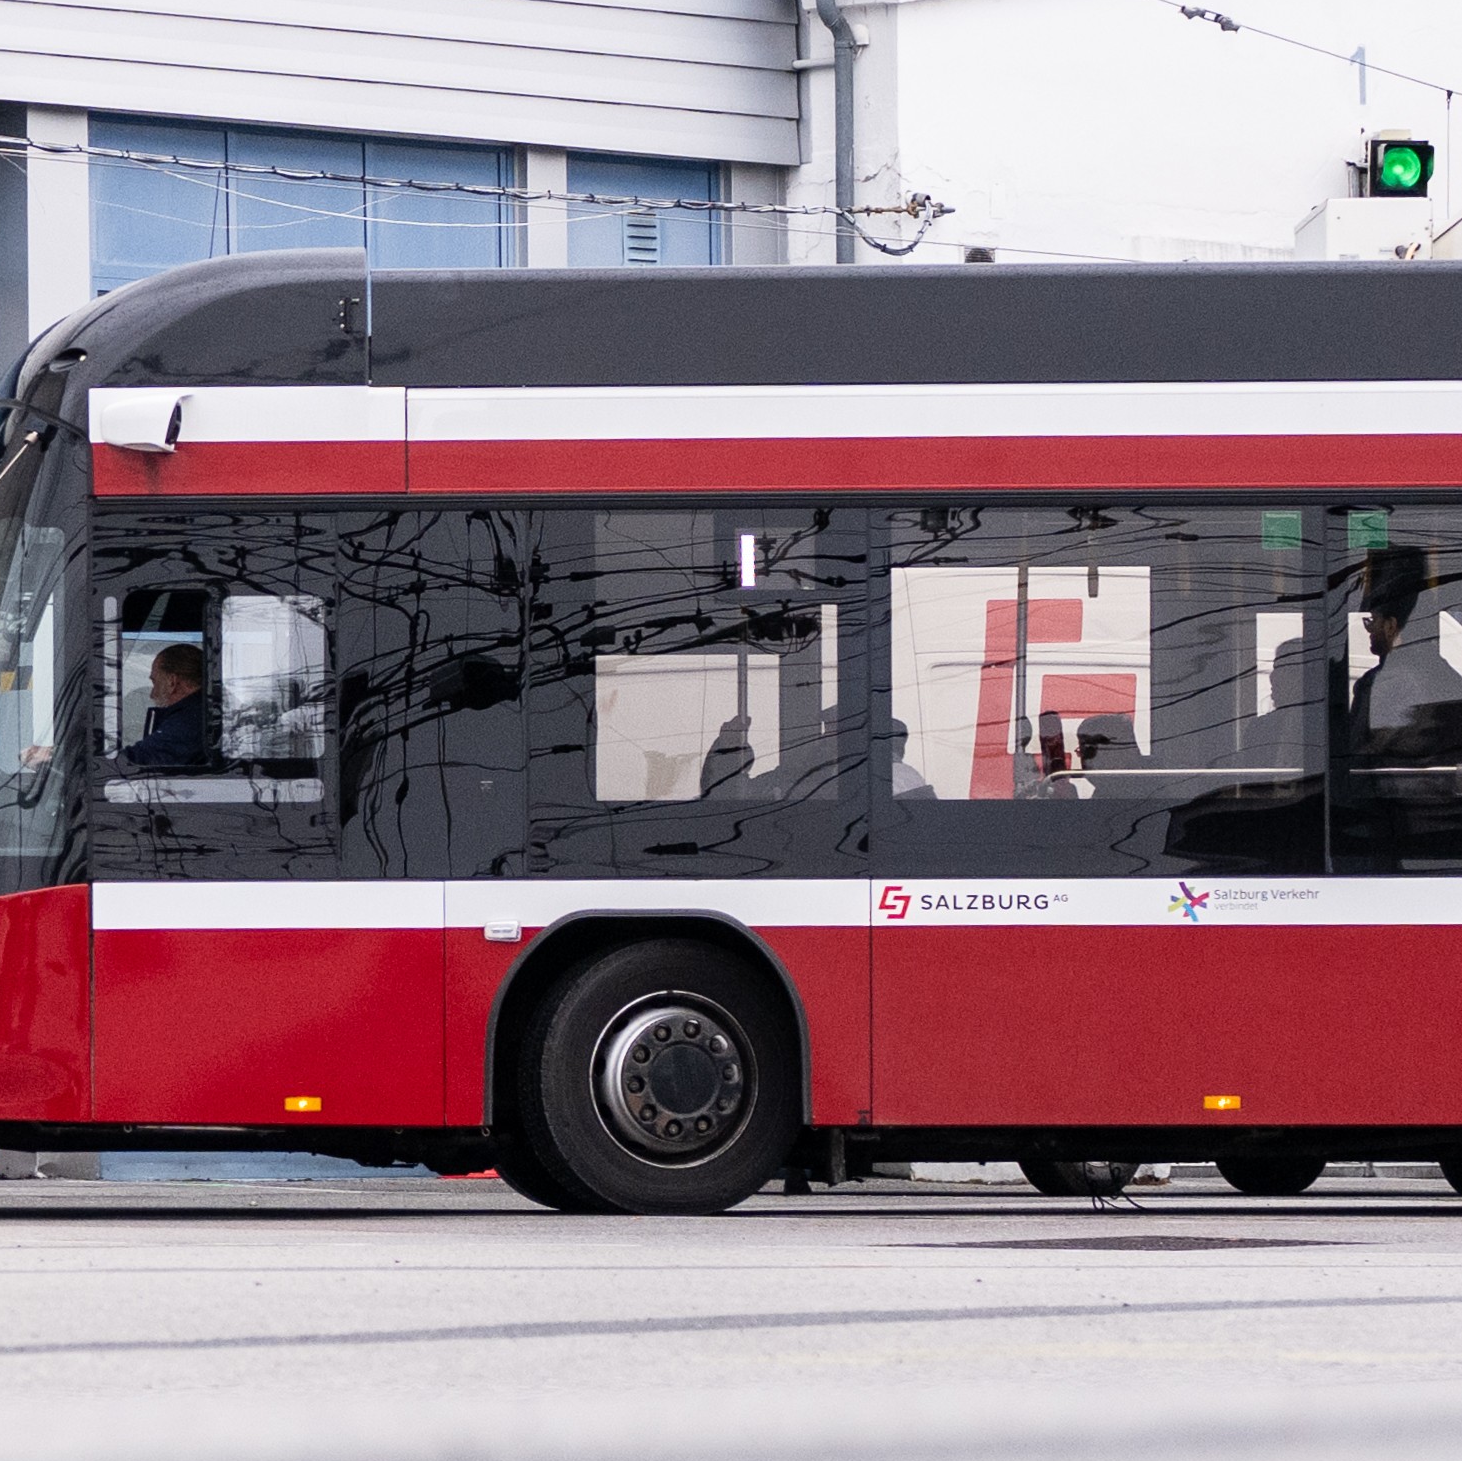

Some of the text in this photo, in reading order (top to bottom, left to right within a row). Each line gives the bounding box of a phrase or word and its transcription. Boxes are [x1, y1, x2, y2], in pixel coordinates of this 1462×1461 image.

[1350, 43, 1366, 105] 1
[921, 894, 1069, 910] SALZBURG AG
[1214, 889, 1320, 901] Salzburg Verkehr
[1214, 902, 1259, 911] verbindet
